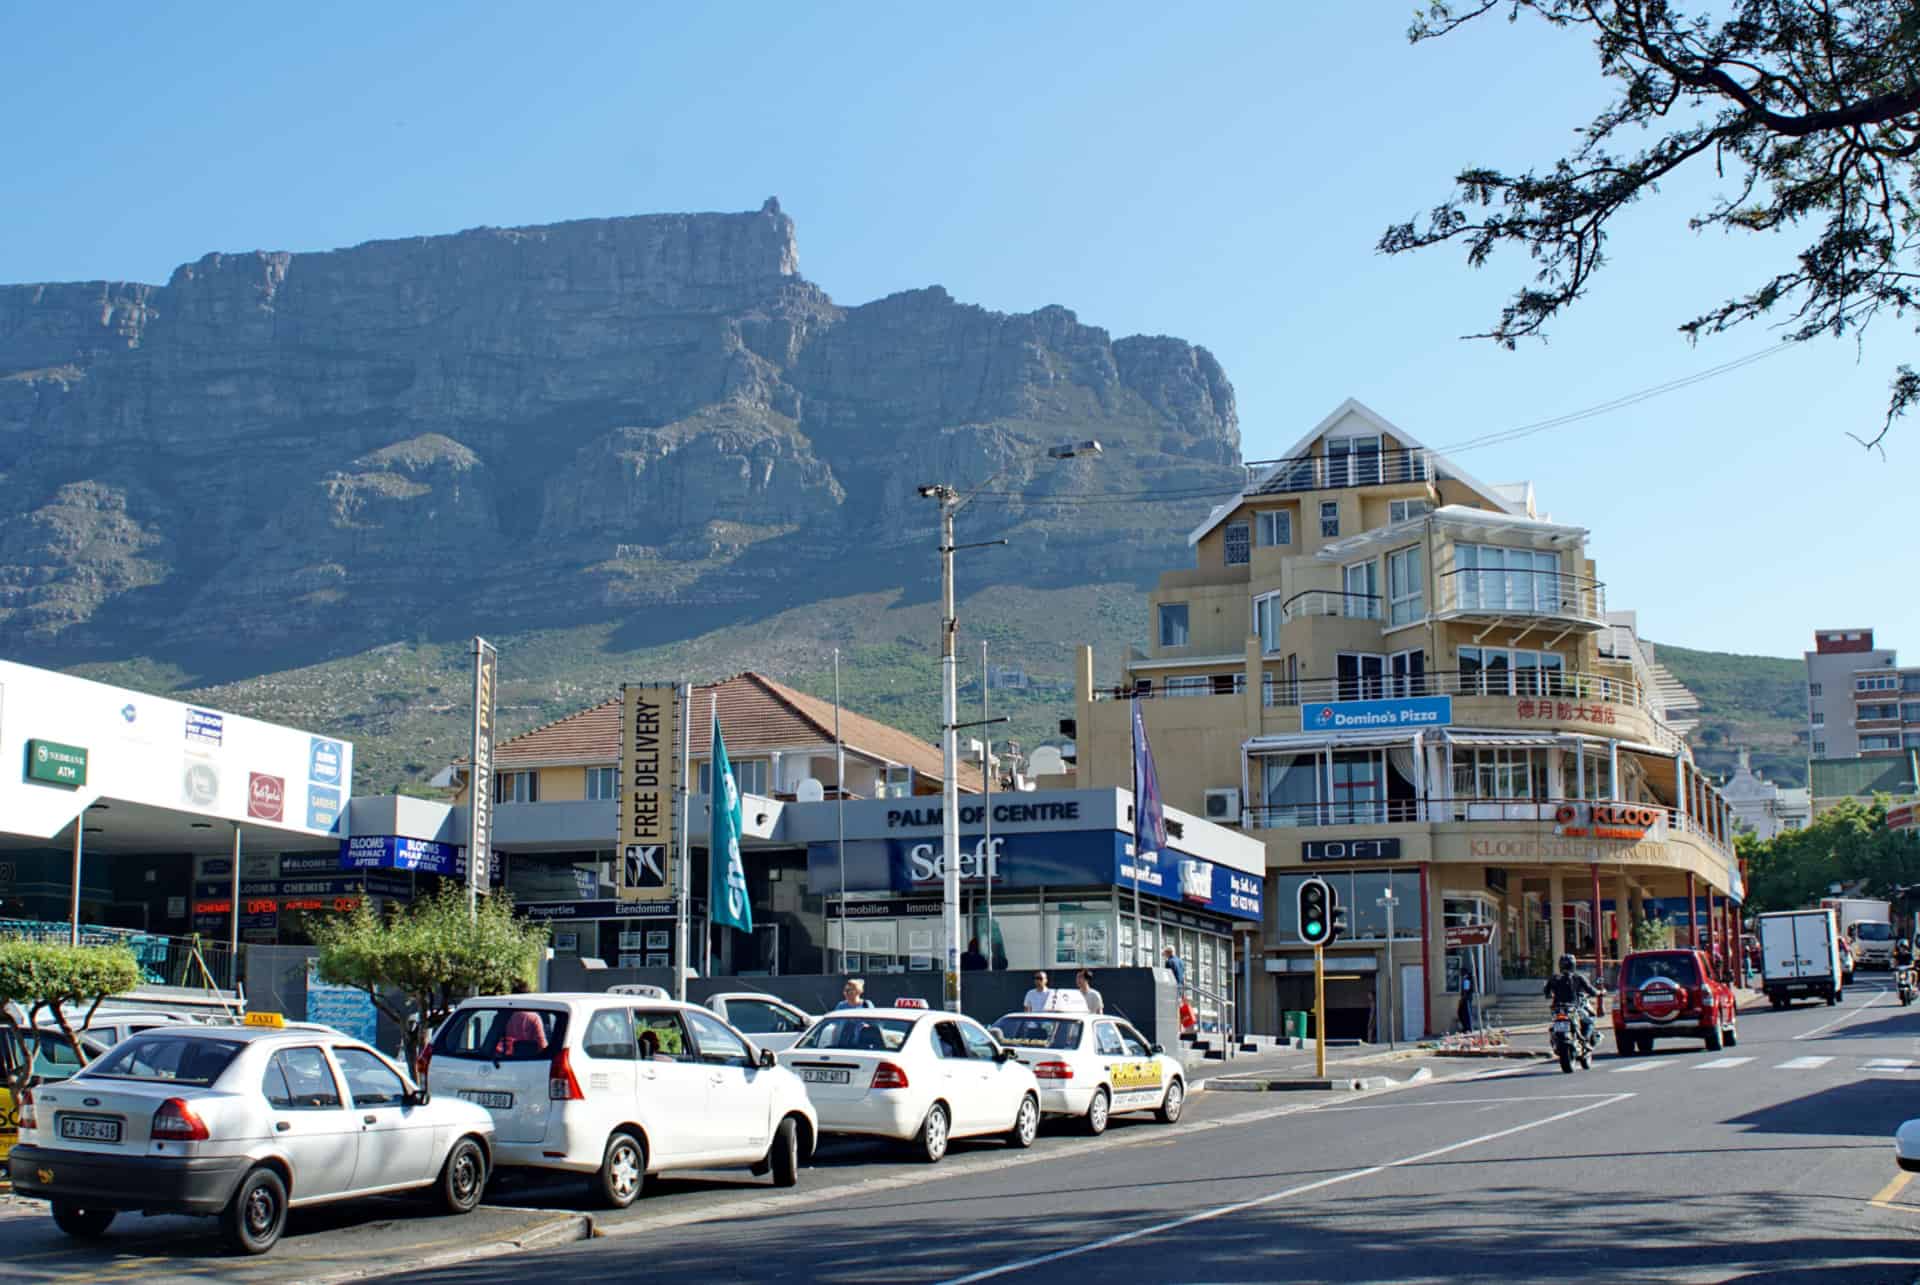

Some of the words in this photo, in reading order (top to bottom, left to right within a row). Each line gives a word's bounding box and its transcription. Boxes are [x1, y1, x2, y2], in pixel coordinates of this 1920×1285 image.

[480, 663, 492, 729] PIZZA
[1335, 710, 1397, 726] Domino's
[1400, 708, 1438, 721] Pizza
[57, 766, 76, 778] ATM
[475, 735, 489, 876] DEBONAIRS
[993, 802, 1080, 819] CENTRE
[634, 791, 658, 838] FREE
[350, 838, 384, 849] BLOOMS
[407, 839, 440, 854] BLOOMS
[1307, 840, 1391, 860] LOFT
[348, 849, 387, 859] PHARMACY
[399, 849, 448, 865] PHARMACY
[354, 858, 380, 867] APTEEK
[283, 882, 332, 894] CHEMIST
[248, 899, 277, 914] OPEN
[528, 905, 575, 916] Properties
[897, 999, 921, 1008] TAXI
[252, 1015, 273, 1025] TAXI
[65, 1120, 76, 1135] CA
